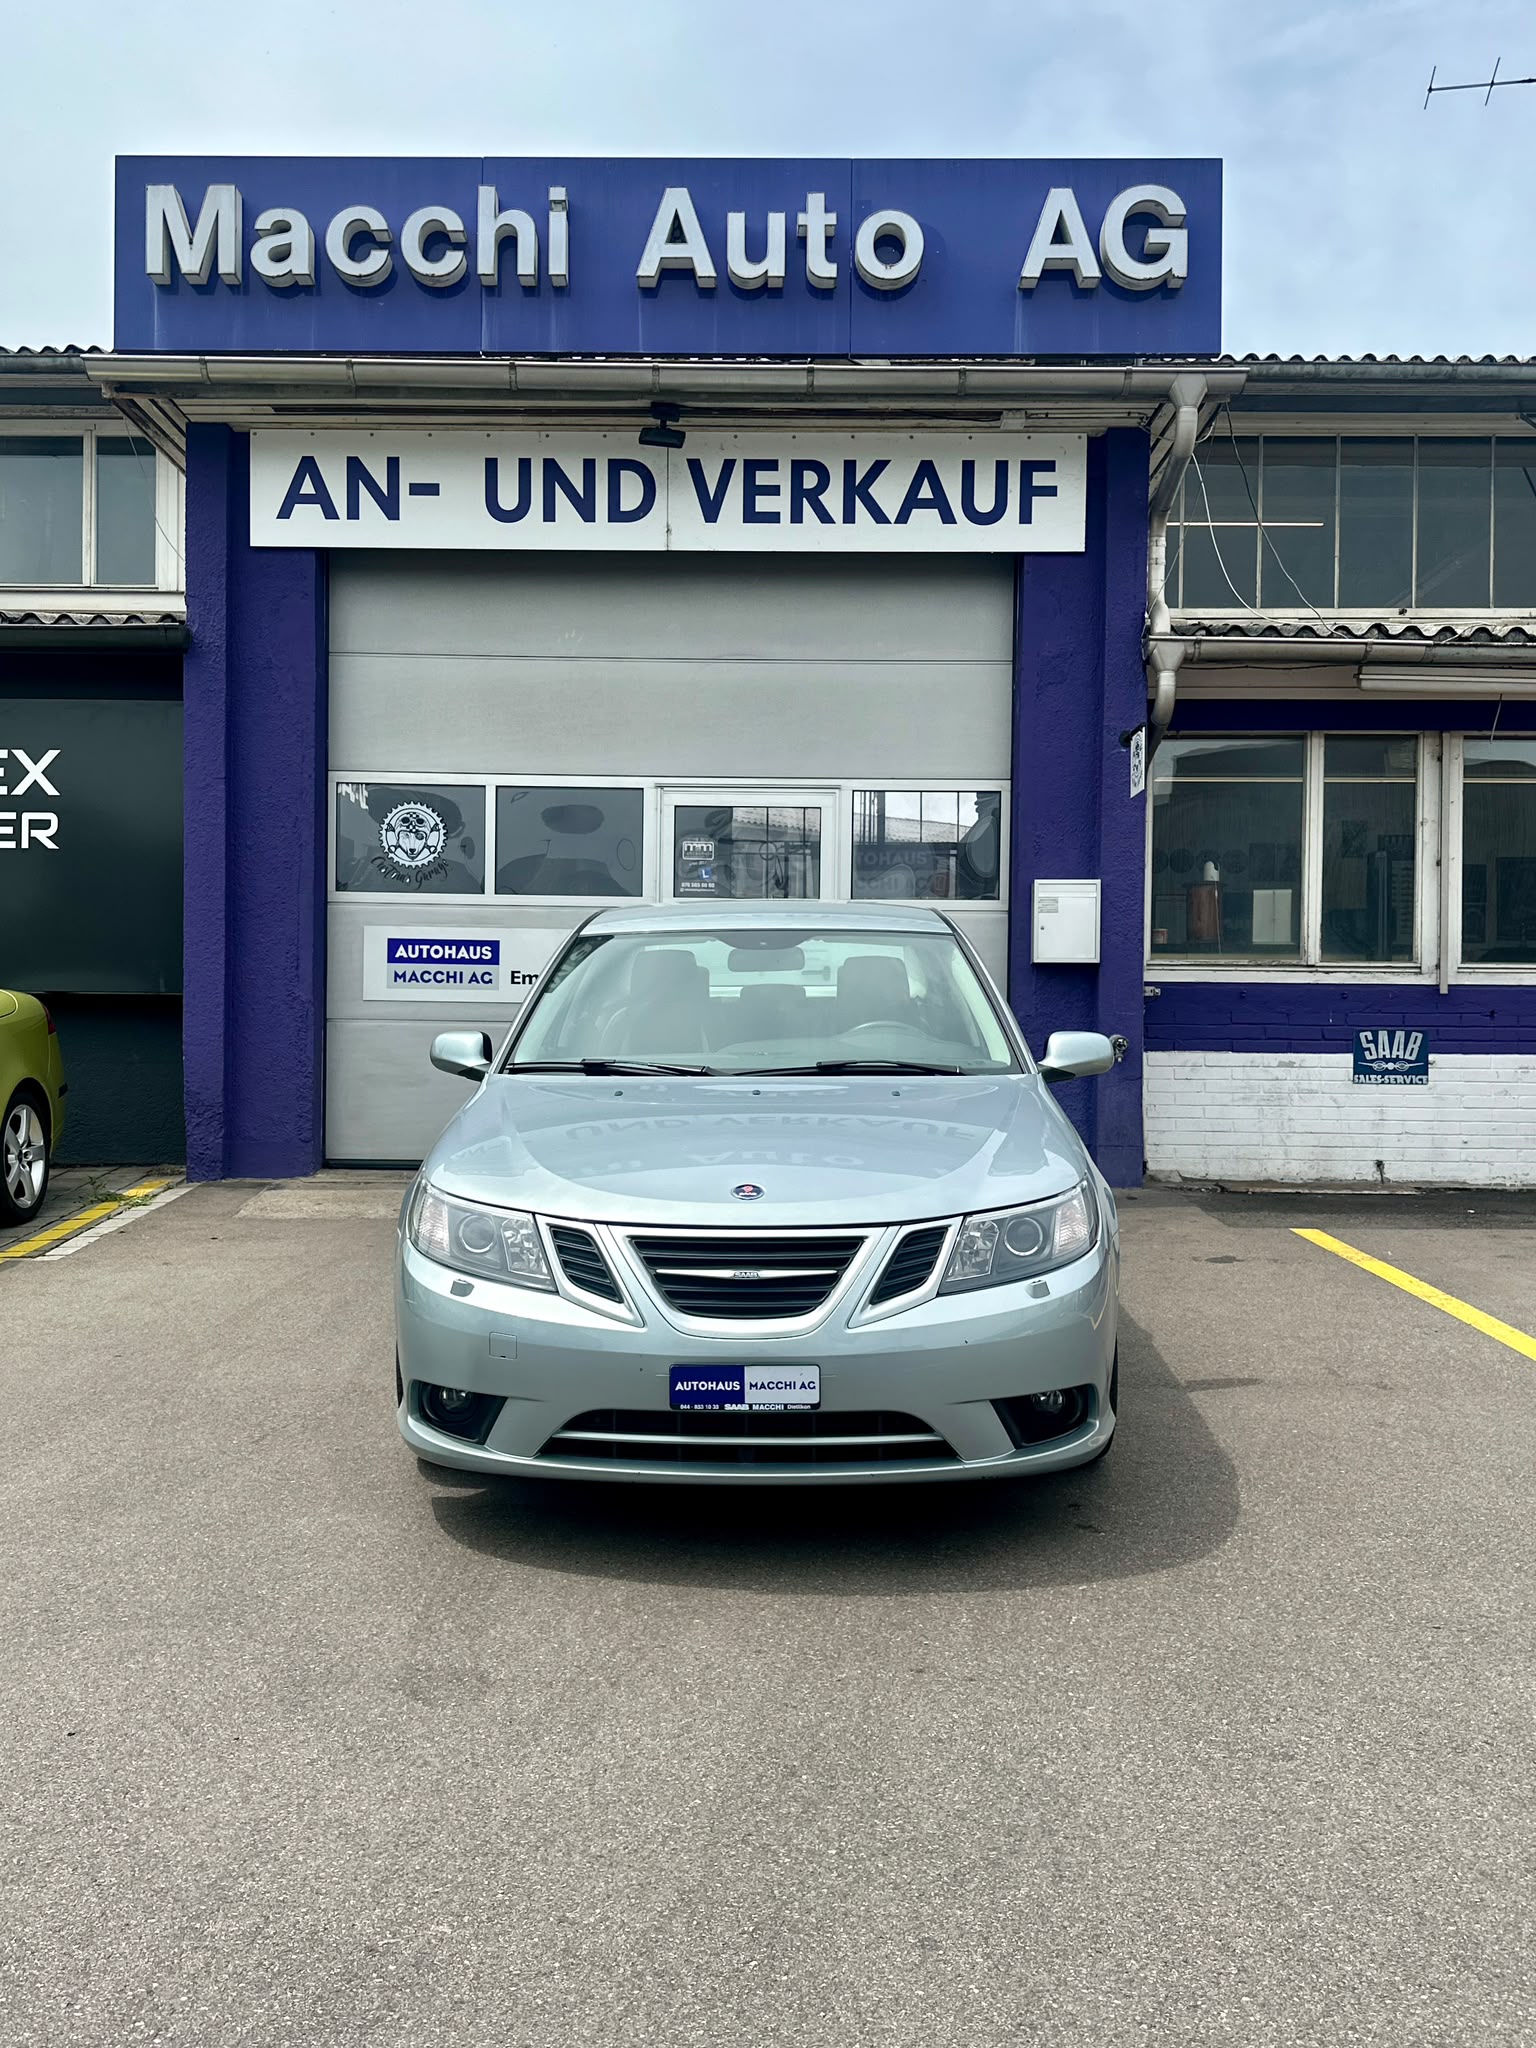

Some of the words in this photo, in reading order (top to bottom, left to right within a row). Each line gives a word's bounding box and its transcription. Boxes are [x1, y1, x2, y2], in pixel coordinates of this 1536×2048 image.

[145, 183, 569, 288] Macchi
[636, 186, 925, 290] Auto
[1018, 184, 1189, 290] AG
[276, 456, 440, 521] AN-
[484, 457, 657, 524] UND
[686, 458, 1058, 526] VERKAUF
[0, 749, 61, 795] X
[395, 944, 492, 960] AUTOHAUS
[394, 970, 463, 984] MACCHI
[468, 971, 493, 985] AG
[1359, 1030, 1423, 1060] SAAB
[675, 1381, 740, 1391] AUTOHAUS
[749, 1381, 796, 1390] MACCHI
[799, 1381, 816, 1390] AG
